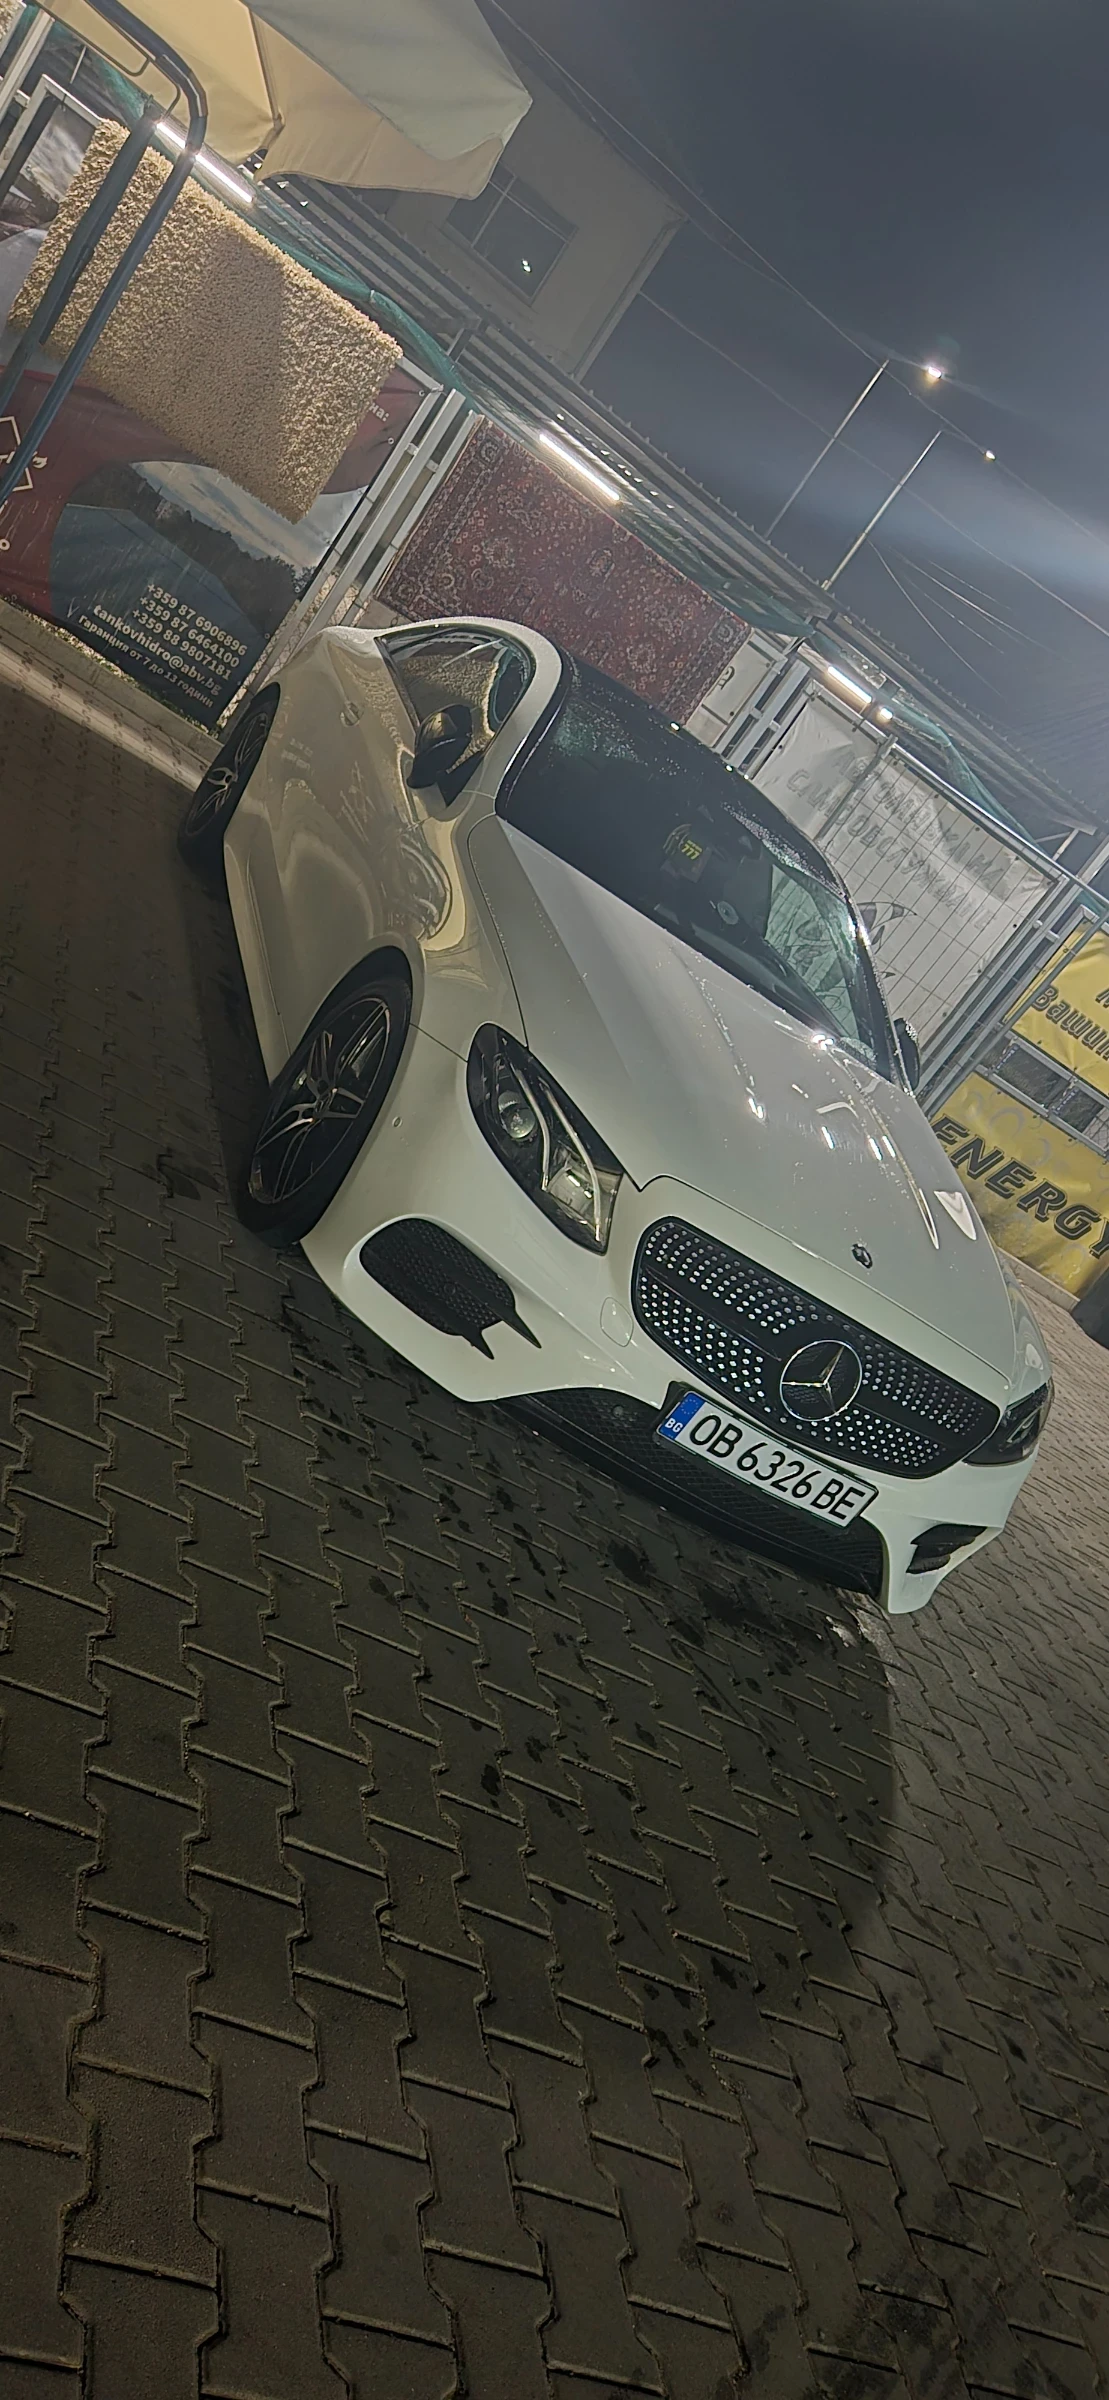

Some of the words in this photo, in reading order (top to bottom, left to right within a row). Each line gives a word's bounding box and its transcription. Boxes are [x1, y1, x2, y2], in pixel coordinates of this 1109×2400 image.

[93, 604, 223, 696] tankovhidro@abv.bg
[132, 609, 163, 634] +359
[163, 629, 180, 645] 88
[180, 640, 232, 681] 9807181
[140, 596, 171, 621] +359
[170, 617, 188, 632] 87
[188, 628, 240, 668] 6464100
[147, 583, 178, 609] +359
[178, 604, 196, 620] 87
[195, 616, 248, 656] 6906896
[79, 614, 129, 653] Гаранция
[129, 649, 143, 661] от
[142, 656, 151, 666] 7
[149, 662, 164, 675] до
[163, 671, 177, 683] 13
[177, 680, 214, 708] години
[665, 1417, 684, 1434] BG
[689, 1414, 743, 1458] OB
[737, 1442, 822, 1499] 6326
[809, 1478, 866, 1520] BE
